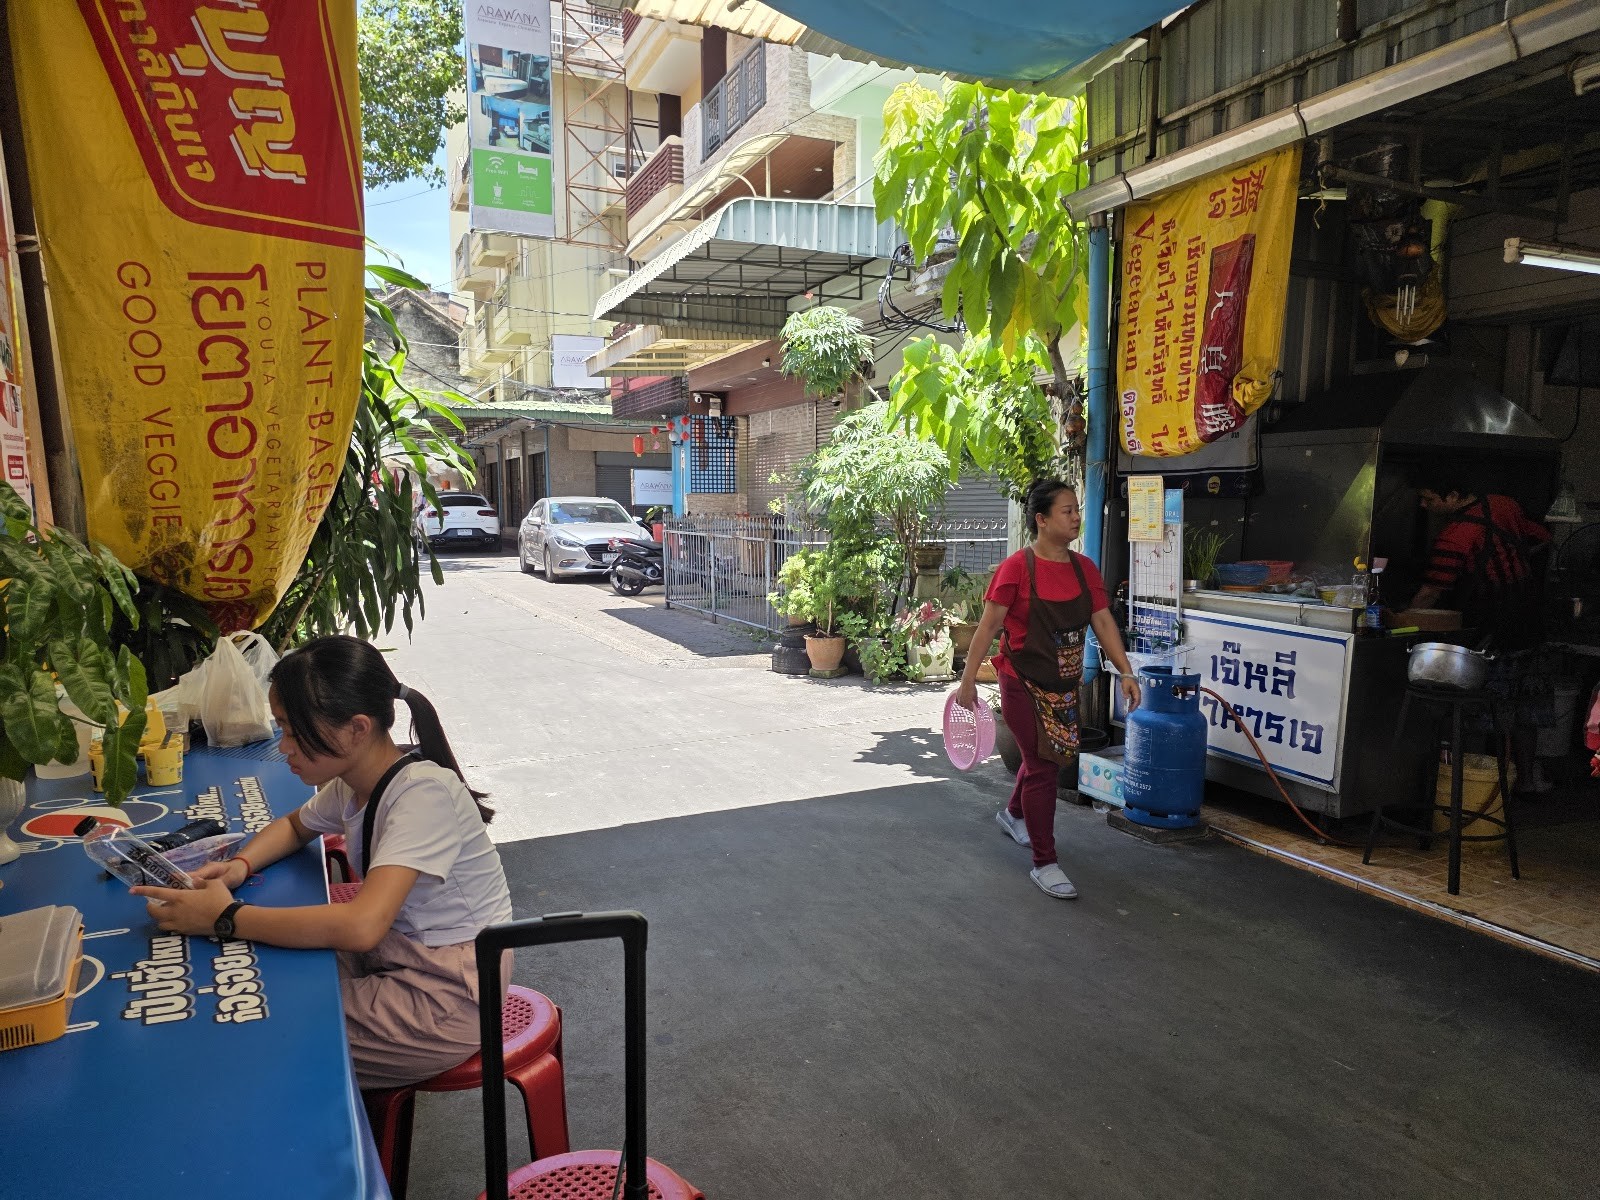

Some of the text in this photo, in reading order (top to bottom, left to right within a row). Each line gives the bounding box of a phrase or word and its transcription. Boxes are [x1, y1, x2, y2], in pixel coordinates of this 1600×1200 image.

[478, 5, 540, 26] ARAWANA
[170, 0, 306, 185] บุญ
[1208, 187, 1227, 219] เจ
[117, 261, 166, 386] GOOD
[256, 297, 275, 386] YOUTA
[1124, 212, 1156, 372] Vegetarian
[1173, 235, 1206, 453] เชิญชวนทุกท่าน ละ
[296, 262, 335, 524] PLANT-BASED
[560, 355, 584, 363] ARAW
[188, 263, 268, 601] โยตาอาหารเจ
[264, 405, 281, 552] VEGETARIAN
[1210, 640, 1297, 699] เจ๊หลี
[1202, 696, 1324, 754] าหารเจ
[197, 938, 263, 1024] ก็อร่อยเห
